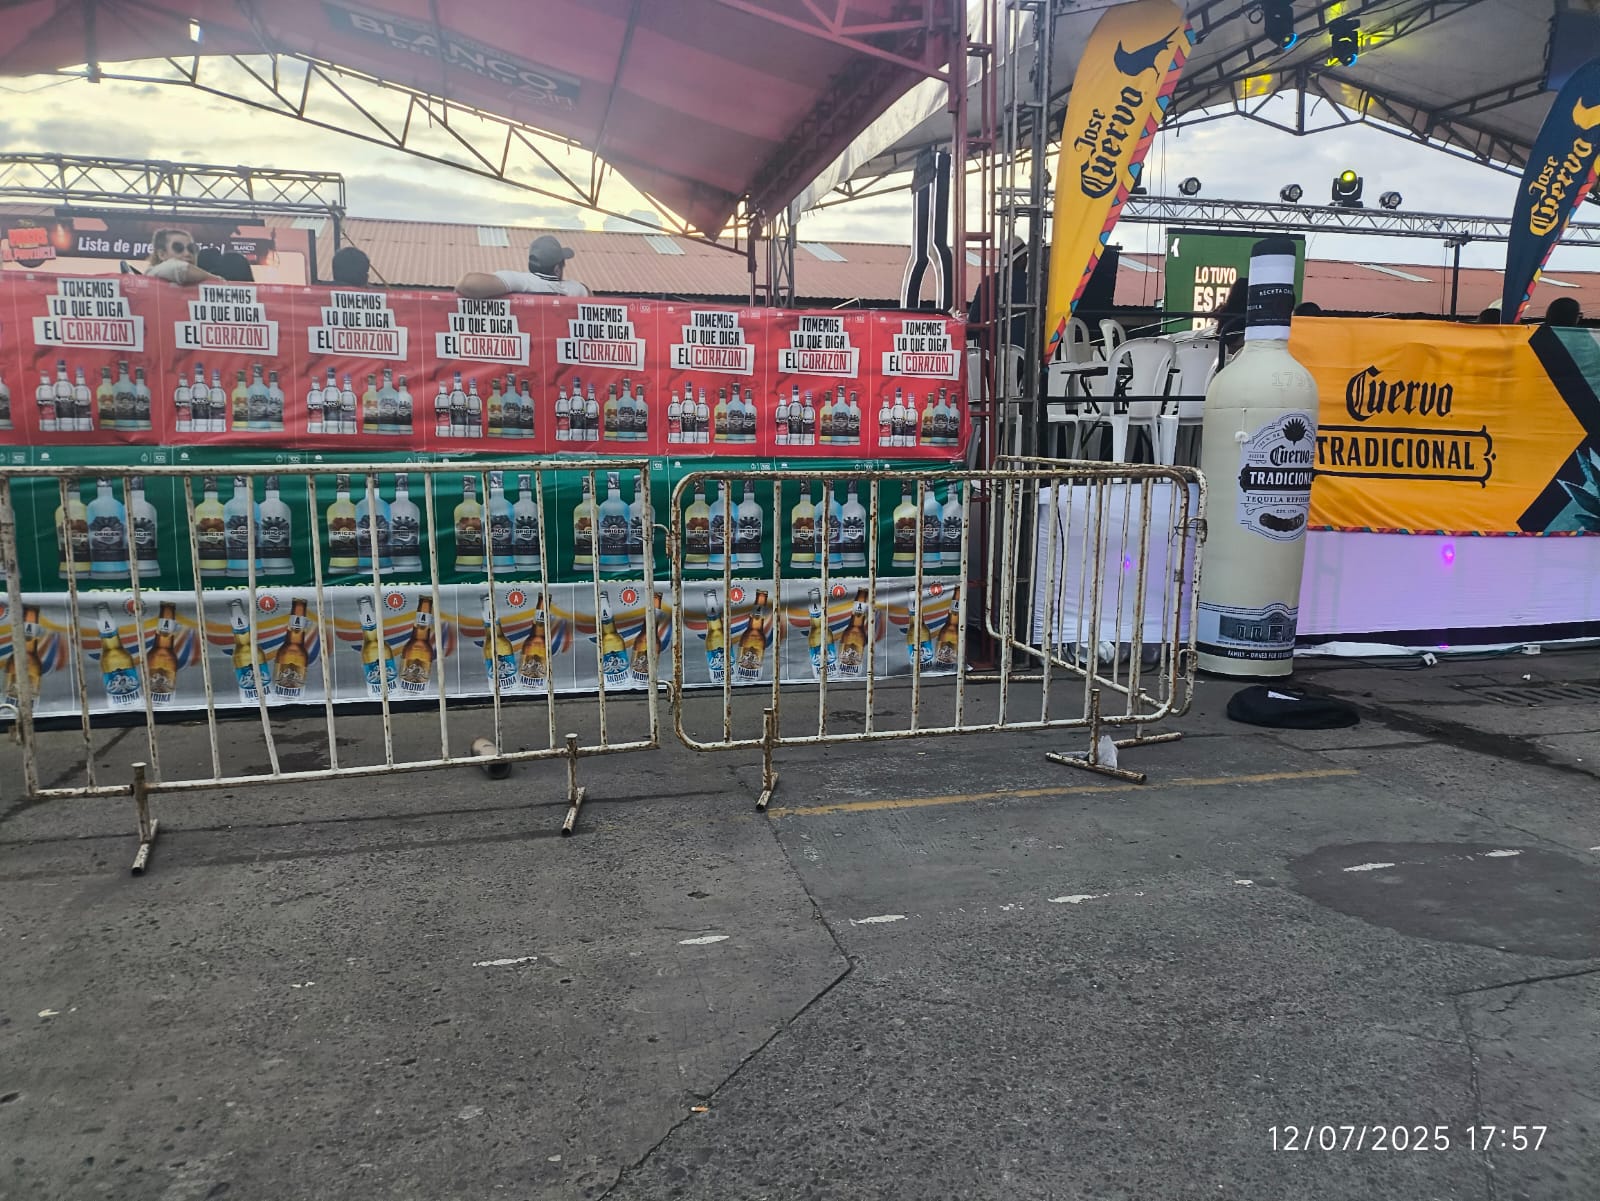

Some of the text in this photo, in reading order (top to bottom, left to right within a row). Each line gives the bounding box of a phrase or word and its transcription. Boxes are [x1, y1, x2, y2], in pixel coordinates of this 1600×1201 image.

[352, 15, 557, 90] BLANCO
[1074, 108, 1106, 152] Jose
[1080, 86, 1143, 198] Cuervo
[1528, 155, 1558, 196] Jose
[1530, 138, 1592, 236] Cuervo
[78, 238, 110, 252] Lista
[114, 240, 130, 253] de
[1195, 266, 1237, 284] LO TUYO
[62, 281, 114, 298] TOMEMOS
[203, 288, 252, 304] TOMEMOS
[335, 293, 380, 310] TOMEMOS
[1194, 286, 1214, 312] ES
[54, 300, 123, 318] LO QUE DIGA
[195, 305, 259, 323] LO QUE DIGA
[462, 300, 505, 316] TOMEMOS
[581, 306, 622, 322] TOMEMOS
[327, 311, 389, 328] LO QUE DIGA
[454, 317, 512, 334] LO QUE DIGA
[695, 313, 734, 328] TOMEMOS
[802, 318, 839, 332] TOMEMOS
[44, 321, 61, 340] EL
[185, 326, 200, 344] EL
[574, 324, 629, 340] LO QUE DIGA
[687, 329, 740, 346] LO QUE DIGA
[906, 322, 941, 336] TOMEMOS
[318, 331, 332, 349] EL
[445, 336, 458, 354] EL
[794, 334, 845, 350] LO QUE DIGA
[898, 338, 947, 353] LO QUE DIGA
[565, 342, 578, 359] EL
[678, 348, 691, 365] EL
[786, 352, 798, 368] EL
[890, 356, 901, 371] EL
[1346, 365, 1453, 422] Cuervo
[1270, 445, 1310, 466] Cuervo
[1316, 436, 1474, 470] TRADICIONAL
[1246, 496, 1284, 504] TEQUILA
[105, 621, 110, 629] A
[401, 680, 425, 691] ANDINA
[112, 692, 140, 704] ANDINA
